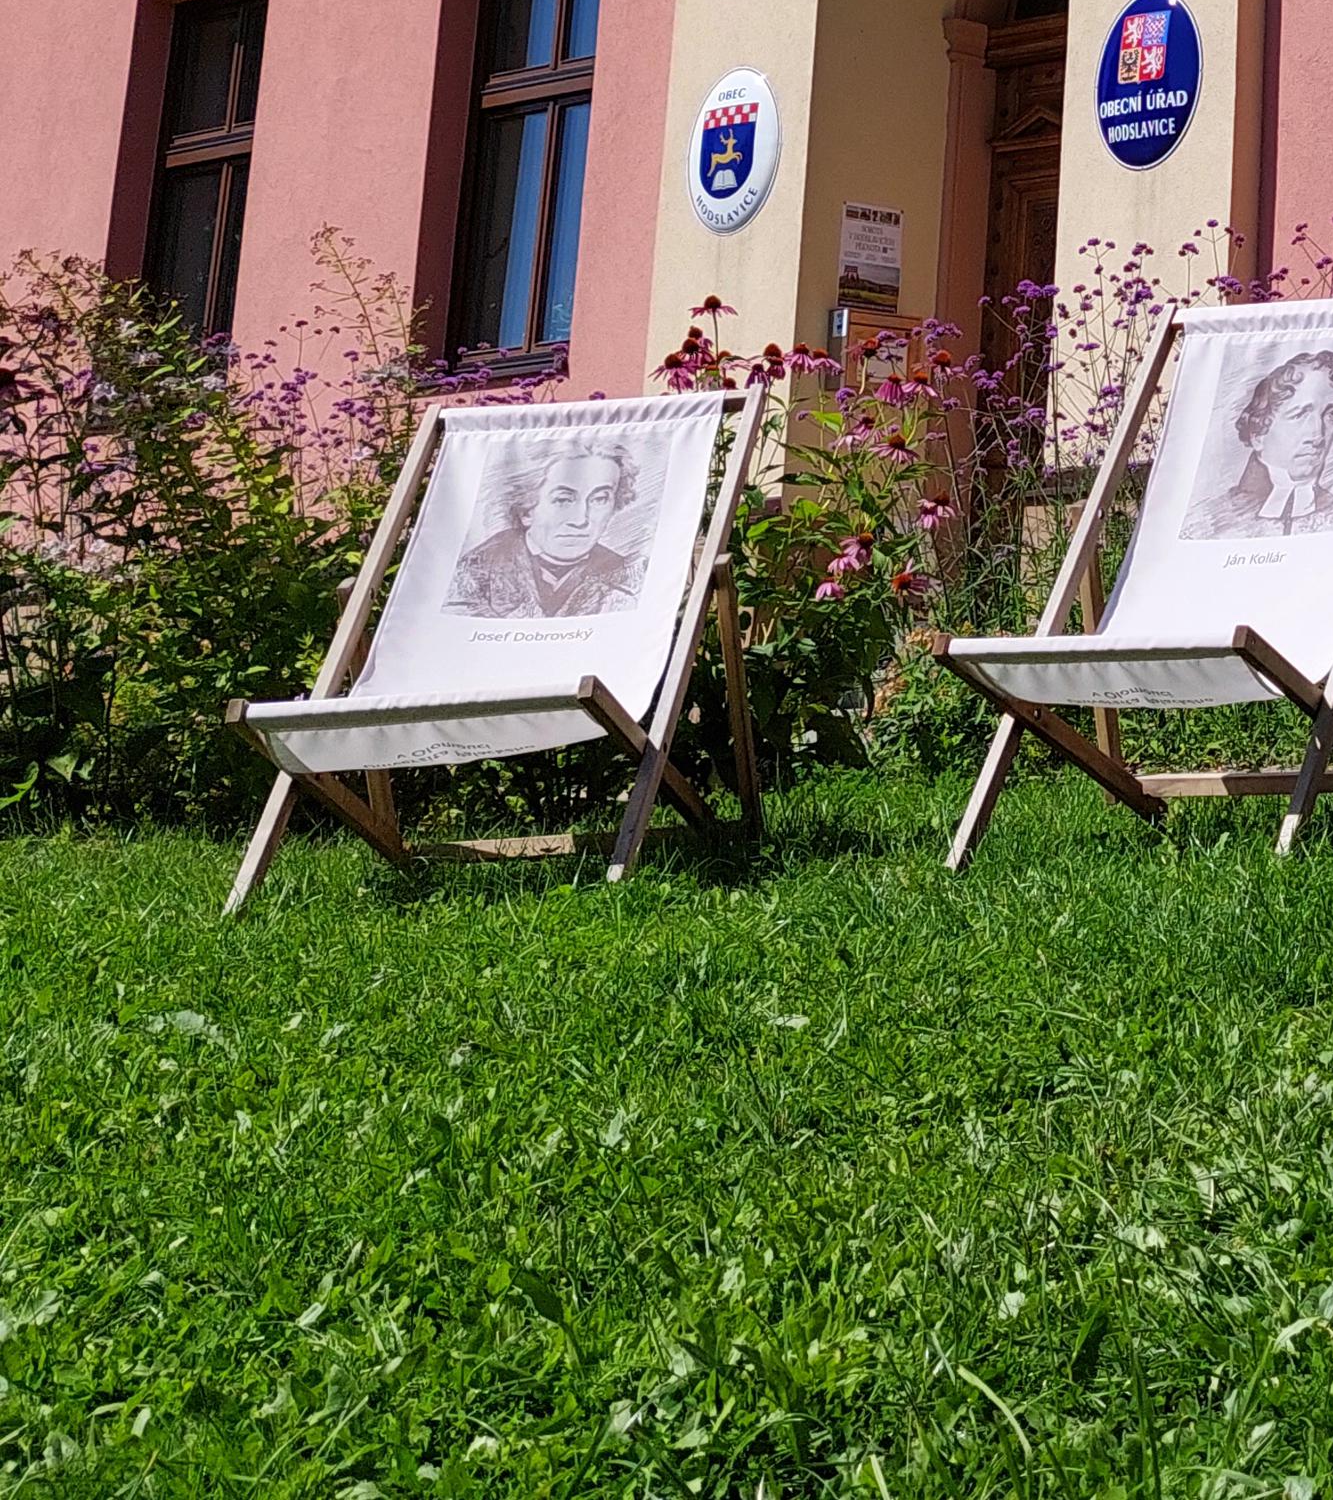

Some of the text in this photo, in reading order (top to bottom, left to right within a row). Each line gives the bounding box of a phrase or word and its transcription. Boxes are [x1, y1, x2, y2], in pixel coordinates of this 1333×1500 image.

[718, 87, 747, 102] OBEC
[1099, 88, 1188, 119] OBECNÍ ÚŘAD
[1108, 117, 1176, 144] HODSLAVICE
[695, 186, 759, 226] HODSLAVICE
[1223, 551, 1287, 568] Ján Kollár
[469, 627, 593, 643] Josef Dobrovský
